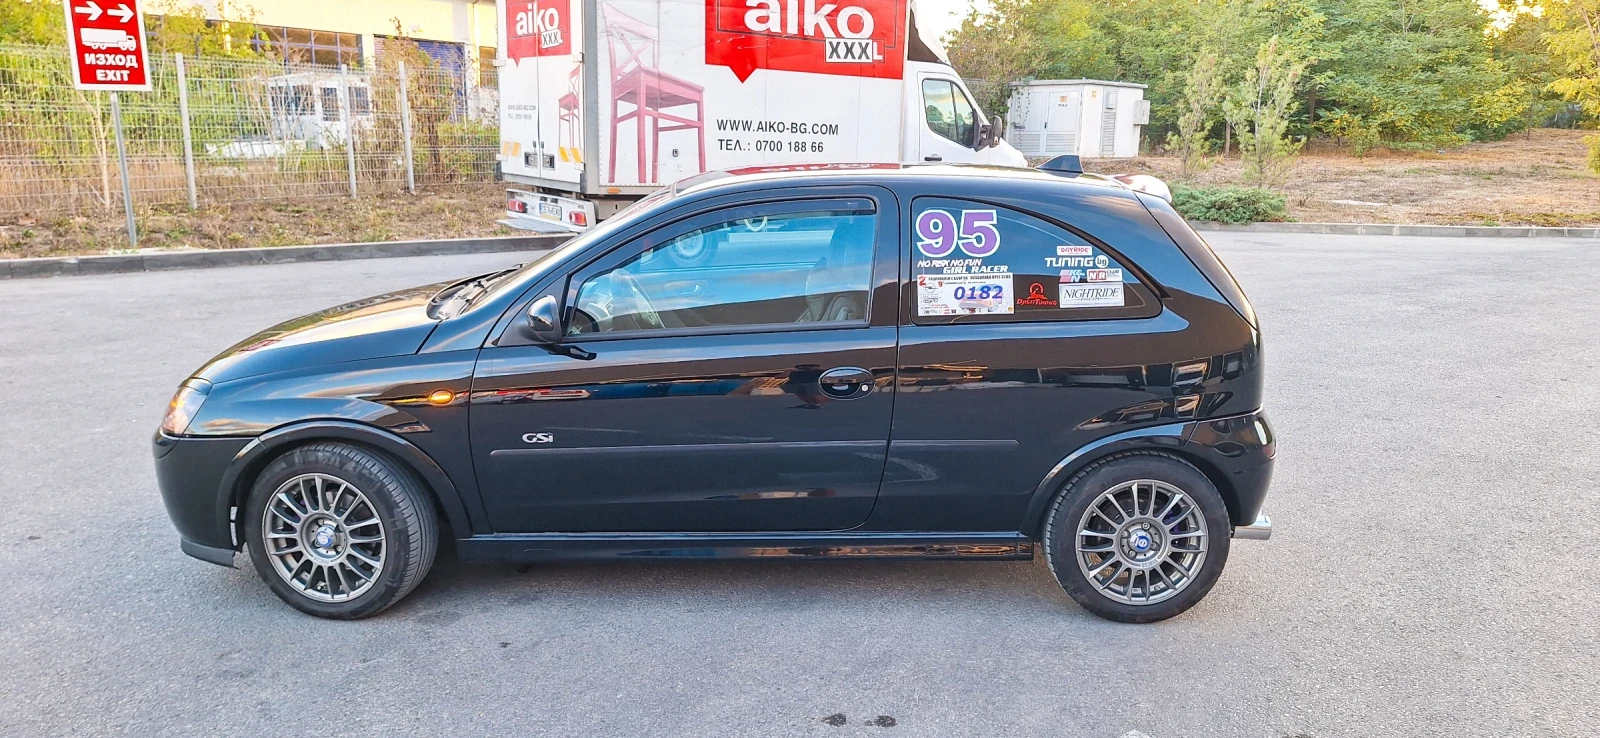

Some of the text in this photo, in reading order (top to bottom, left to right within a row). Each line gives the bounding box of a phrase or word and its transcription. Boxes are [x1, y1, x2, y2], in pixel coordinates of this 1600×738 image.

[516, 3, 560, 36] aiko
[744, 0, 875, 39] aiko
[827, 40, 884, 61] XXXL
[84, 53, 139, 68] ИЗХОД
[96, 69, 130, 81] EXIT
[716, 119, 839, 135] WWW.AIKO-BG.COM
[718, 139, 824, 152] ТЕЛ.: 0700 188 66
[915, 209, 1001, 257] 95
[917, 260, 930, 268] NO
[950, 259, 964, 267] NO
[964, 258, 982, 267] FUN
[1044, 257, 1094, 267] TUNING
[943, 265, 1009, 274] GIRL RACER
[954, 285, 1004, 301] 0182
[1063, 288, 1120, 298] NIGHTRIDE
[522, 432, 554, 443] GSi
